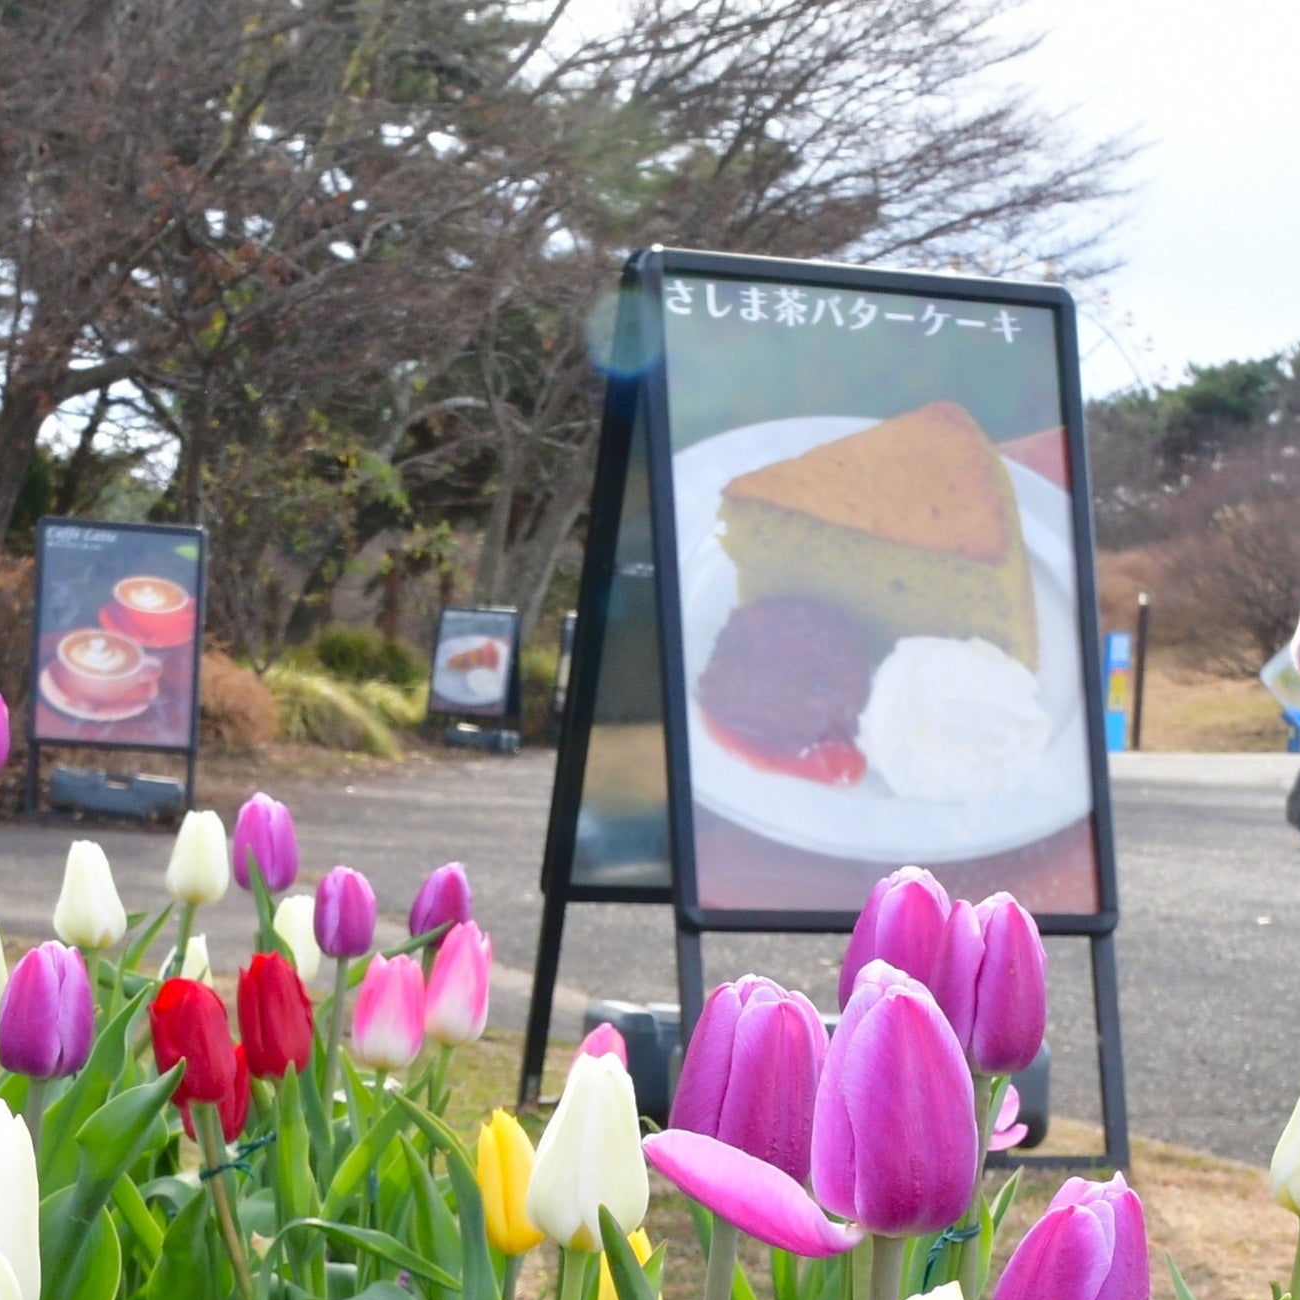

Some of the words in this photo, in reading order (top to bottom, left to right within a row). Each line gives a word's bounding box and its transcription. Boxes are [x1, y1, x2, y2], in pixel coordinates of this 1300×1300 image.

[665, 279, 1022, 343] さしま茶バターケーキ
